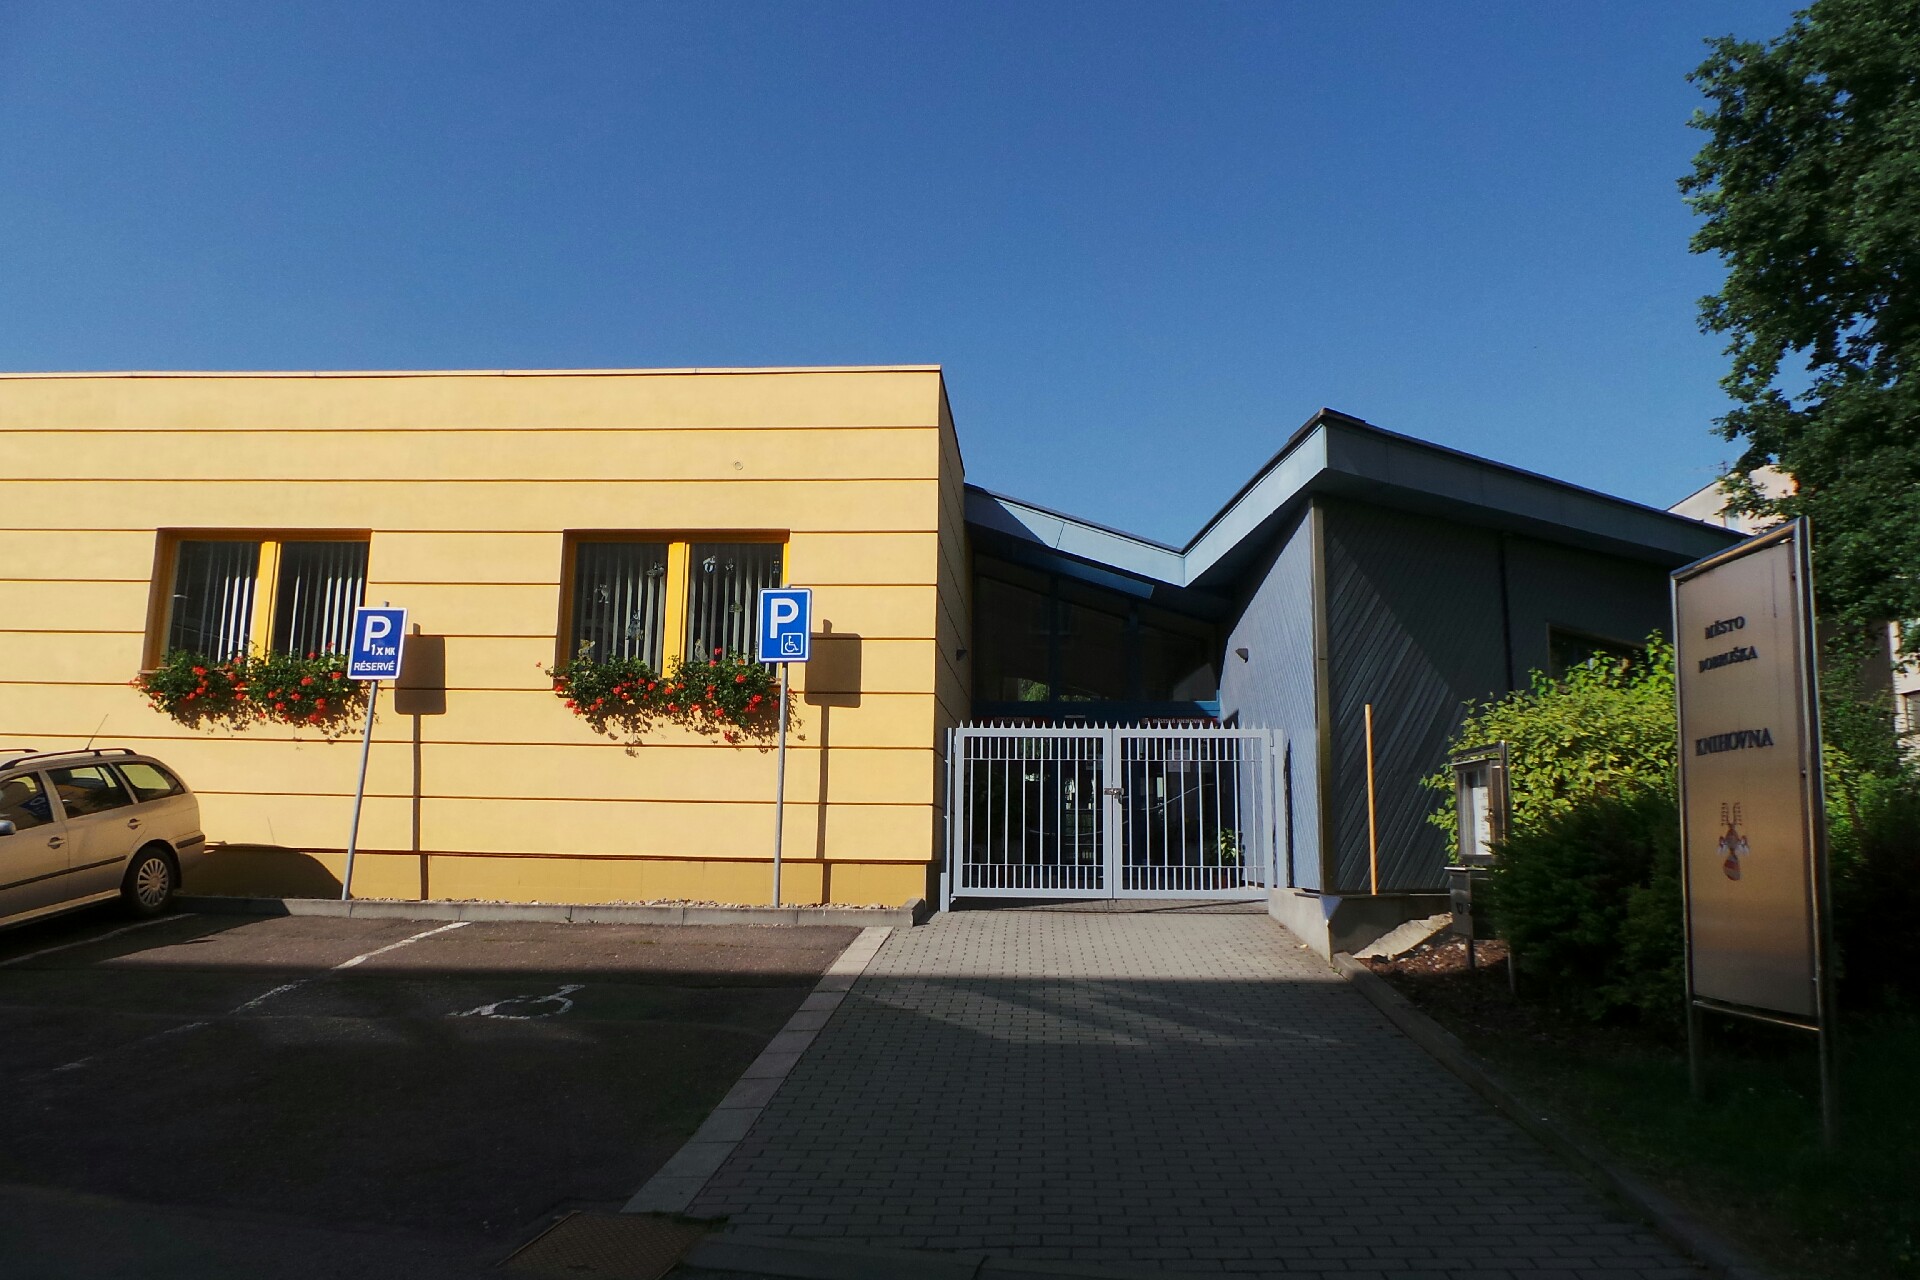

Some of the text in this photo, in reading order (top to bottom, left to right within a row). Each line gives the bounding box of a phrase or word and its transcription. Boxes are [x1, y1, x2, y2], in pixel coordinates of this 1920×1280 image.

[362, 615, 392, 652] P
[770, 598, 799, 639] P
[353, 660, 395, 671] RÉSERVÉ
[1695, 728, 1774, 756] KNIHOVNA
